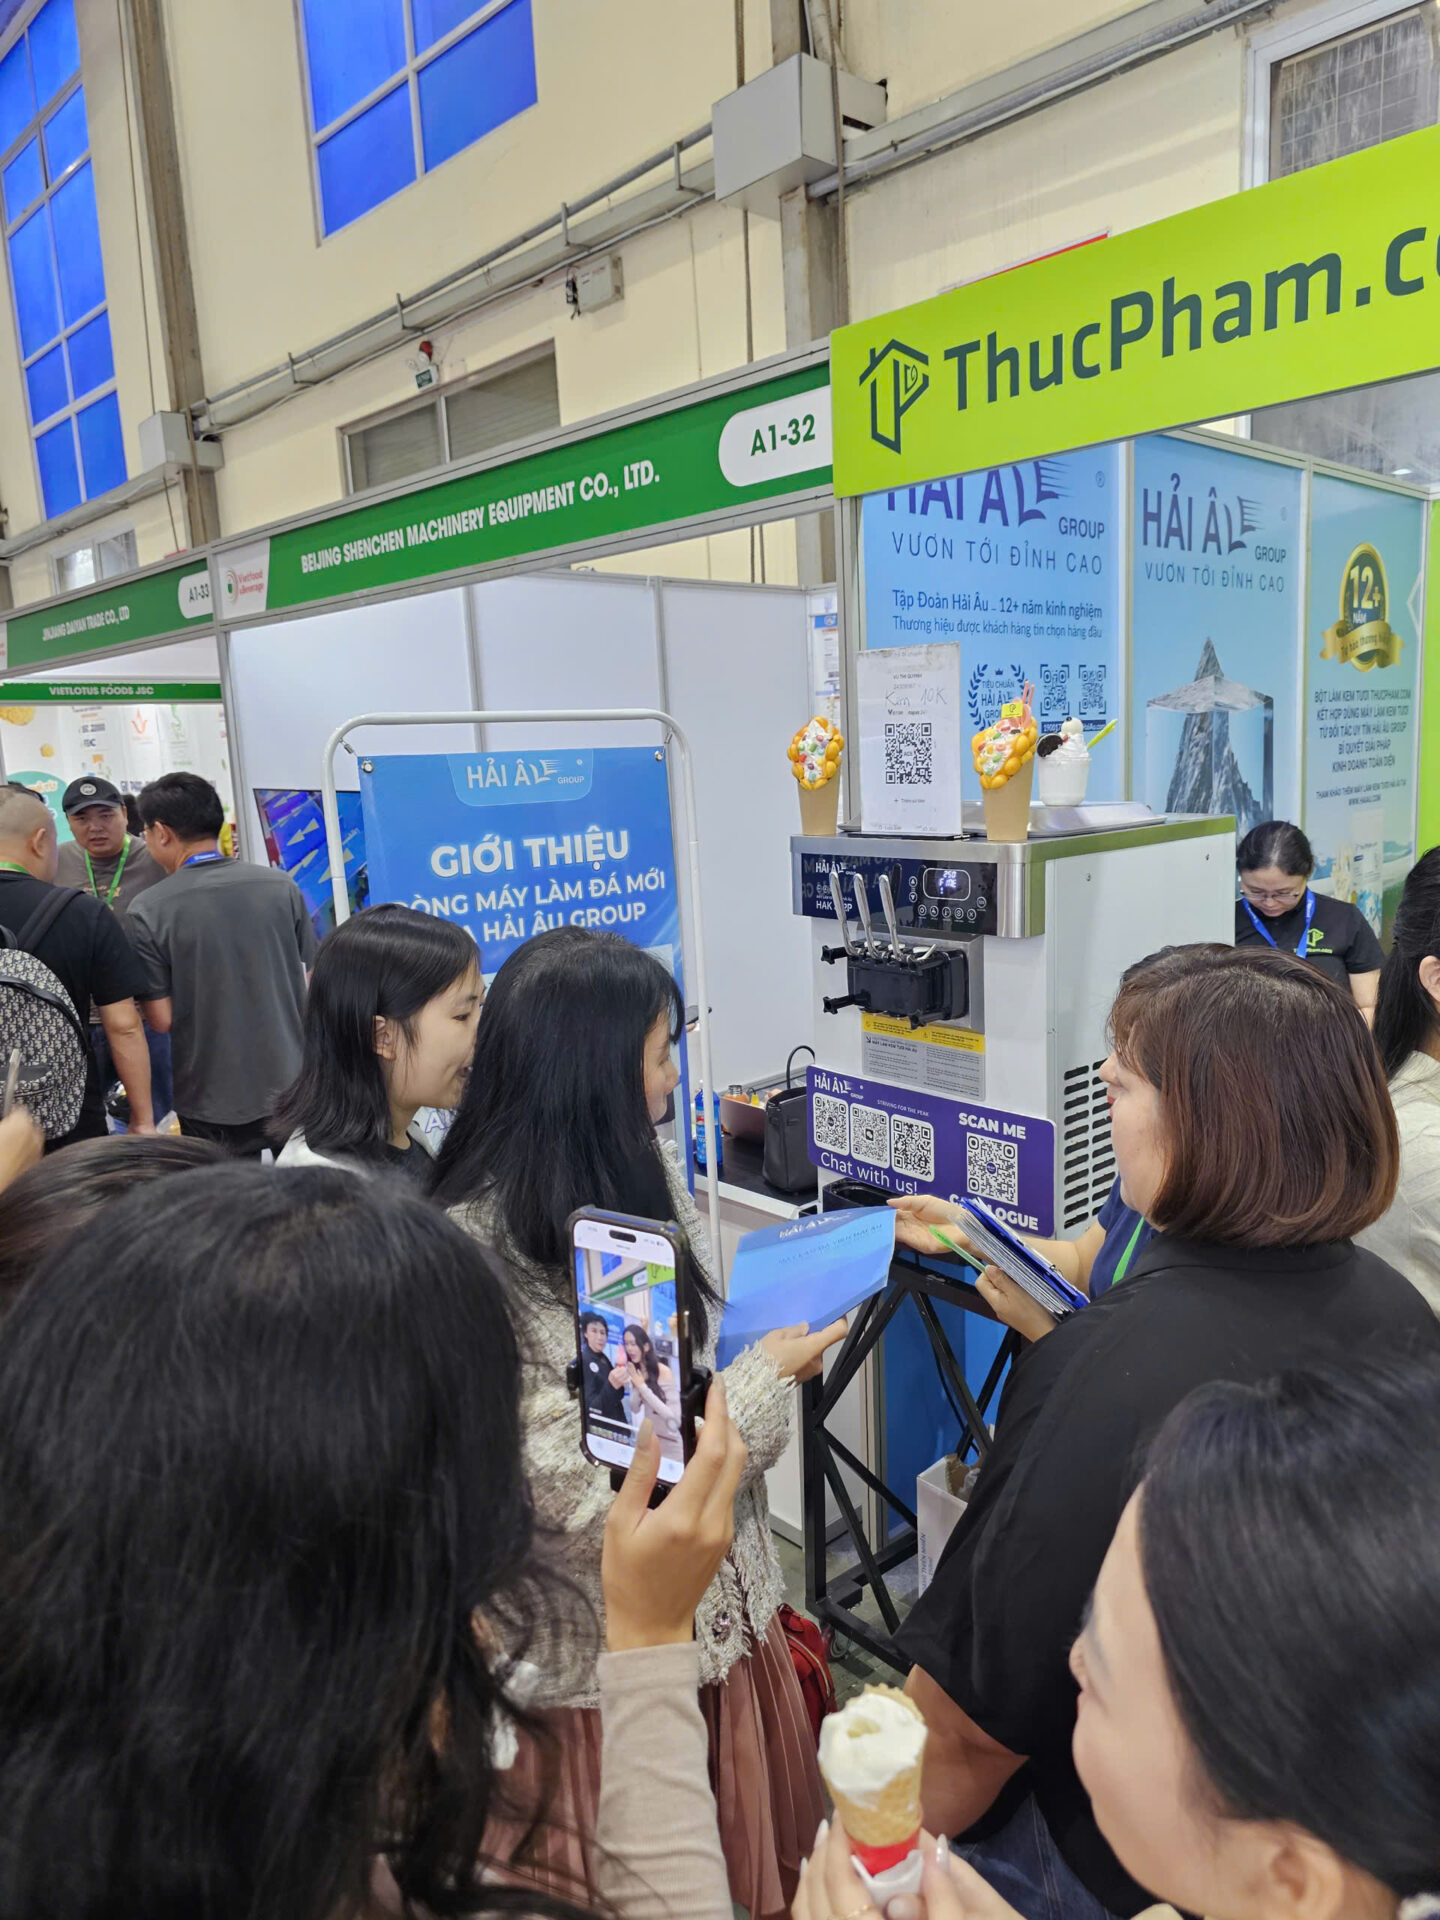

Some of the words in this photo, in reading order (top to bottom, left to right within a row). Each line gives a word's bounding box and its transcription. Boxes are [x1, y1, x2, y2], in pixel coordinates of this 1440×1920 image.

[943, 226, 1440, 411] ThucPham.c
[750, 414, 816, 456] A1-32
[301, 545, 342, 574] BEIJING
[343, 528, 404, 563] SHENCHEN
[406, 506, 485, 546] MACHINERY
[488, 480, 576, 525] EQUIPMENT
[579, 472, 619, 500] CO.,
[624, 459, 660, 491] LTD.
[1142, 472, 1193, 552] HẢI
[1058, 516, 1105, 539] GROUP
[1066, 552, 1102, 575] CAO
[1254, 545, 1287, 563] GROUP
[188, 584, 209, 603] A1-33
[1259, 574, 1284, 593] CAO
[1350, 565, 1381, 609] 12+
[892, 589, 914, 612] Tập
[917, 591, 949, 609] Đoàn
[952, 593, 971, 610] Hải
[973, 591, 989, 611] Âu
[999, 597, 1019, 613] 12+
[1022, 599, 1043, 615] năm
[1045, 600, 1066, 616] kinh
[1069, 602, 1102, 620] nghiệm
[892, 615, 932, 634] Thương
[934, 617, 954, 635] hiệu
[956, 618, 981, 635] được
[982, 620, 1008, 635] khách
[49, 686, 99, 696] VIETLOTUS
[101, 686, 134, 696] FOODS
[135, 686, 154, 696] JSC
[467, 757, 507, 789] HẢI
[557, 775, 585, 785] GROUP
[431, 833, 514, 878] GIỚI
[523, 825, 629, 871] THIỆU
[475, 884, 528, 912] MÁY
[534, 878, 583, 905] LÀM
[588, 873, 621, 898] ĐÁ
[626, 867, 666, 892] MỚI
[816, 901, 832, 910] HAK
[483, 913, 525, 943] HẢI
[570, 901, 647, 928] GROUP
[814, 1072, 830, 1091] HẢI
[907, 1106, 917, 1114] THE
[958, 1112, 999, 1134] SCAN
[1003, 1122, 1027, 1140] ME
[820, 1152, 853, 1177] Chat
[857, 1164, 890, 1188] with
[895, 1178, 918, 1196] us!
